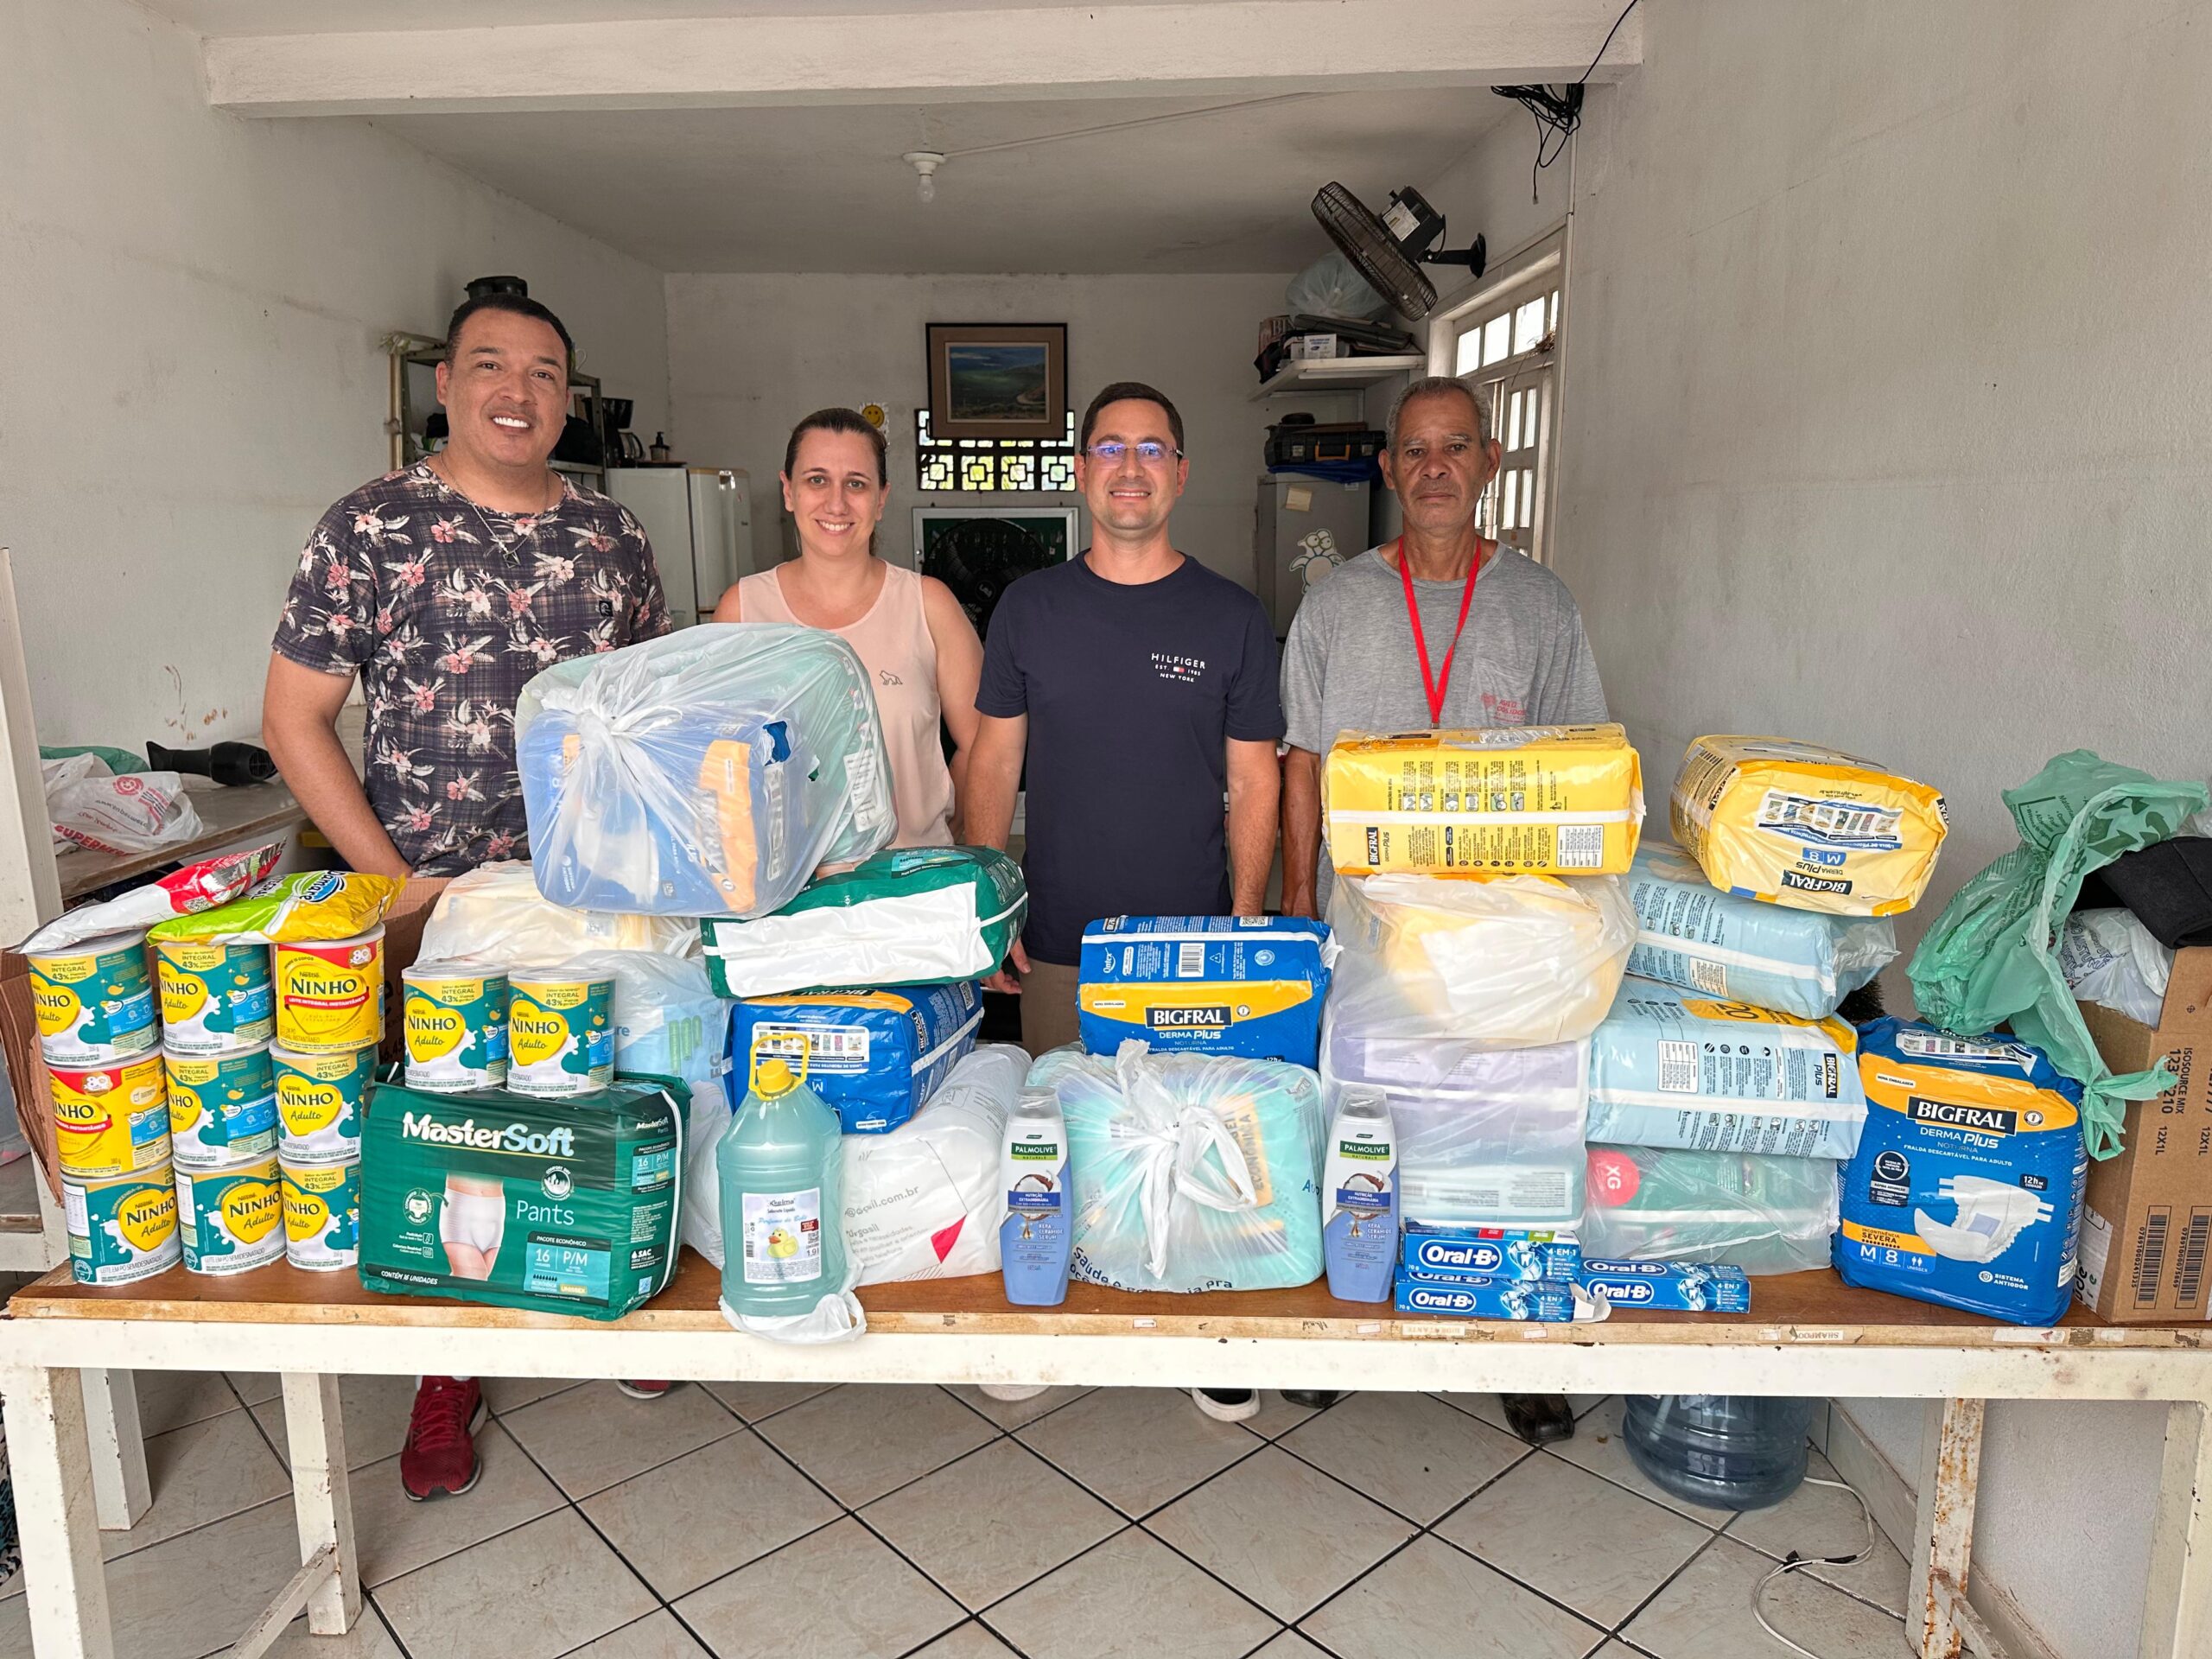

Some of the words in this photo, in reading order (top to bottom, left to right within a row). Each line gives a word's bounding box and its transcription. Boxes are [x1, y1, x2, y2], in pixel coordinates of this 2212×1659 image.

[1151, 652, 1206, 670] HILFIGER
[1368, 830, 1379, 863] BIGFRAL
[1809, 851, 1819, 861] 8
[1827, 854, 1841, 865] M
[1789, 873, 1847, 893] BIGFRAL
[291, 977, 358, 995] NINHO
[1154, 1009, 1224, 1025] BIGFRAL
[1716, 1002, 1759, 1020] 20
[408, 1017, 457, 1031] NINHO
[512, 1018, 561, 1034] NINHO
[415, 1035, 446, 1046] Adulto
[518, 1039, 548, 1050] Adulto
[317, 1063, 350, 1071] INTEGRAL
[2177, 1047, 2193, 1096] ISOSOURCE
[1826, 1053, 1837, 1098] BIGFRAL
[2162, 1048, 2181, 1114] 123210
[811, 1080, 823, 1092] M
[169, 1093, 194, 1108] NHO
[282, 1090, 334, 1106] NINHO
[2176, 1097, 2186, 1115] MIX
[54, 1101, 94, 1119] INHO
[290, 1109, 322, 1122] Adulto
[1916, 1100, 2006, 1130] BIGFRAL
[636, 1116, 669, 1130] MasterSoft
[403, 1111, 576, 1157] MasterSoft
[1920, 1127, 1961, 1141] DERMA
[2155, 1126, 2168, 1155] 12X1L
[2198, 1126, 2211, 1156] 12X1L
[1344, 1143, 1386, 1154] PALMOLIVE
[1904, 1144, 1927, 1154] FRALDA
[1928, 1147, 1970, 1160] DESCARTÁVEL
[1937, 1141, 1979, 1154] NOTURNA
[638, 1157, 649, 1167] 16
[1605, 1164, 1622, 1190] XG
[2024, 1175, 2038, 1185] 12h
[126, 1196, 175, 1226] NINHO
[229, 1190, 281, 1218] NINHO
[516, 1199, 575, 1226] Pants
[141, 1219, 172, 1237] Adulto
[244, 1212, 276, 1230] Adulto
[1861, 1232, 1897, 1244] SEVERA
[1862, 1228, 1900, 1239] INCONTINÊNCIA
[556, 1238, 587, 1247] ECONÔMICO
[536, 1248, 550, 1262] 16
[563, 1250, 588, 1267] P/M
[638, 1249, 652, 1258] SAC
[1426, 1245, 1493, 1266] Oral-B
[1860, 1244, 1877, 1260] M
[1885, 1249, 1898, 1263] 8
[2131, 1227, 2145, 1288] 07891000241325
[2173, 1227, 2188, 1288] 07891000075869
[1073, 1246, 1109, 1284] Saúde
[1592, 1262, 1656, 1273] Oral-B
[381, 1269, 404, 1280] CONTÉM
[410, 1274, 438, 1286] UNIDADES
[1206, 1279, 1233, 1289] pra
[1993, 1279, 2029, 1291] ANTIODOR
[1994, 1273, 2024, 1283] SISTEMA
[1592, 1283, 1647, 1299] Oral-B
[1415, 1292, 1469, 1307] Oral-B
